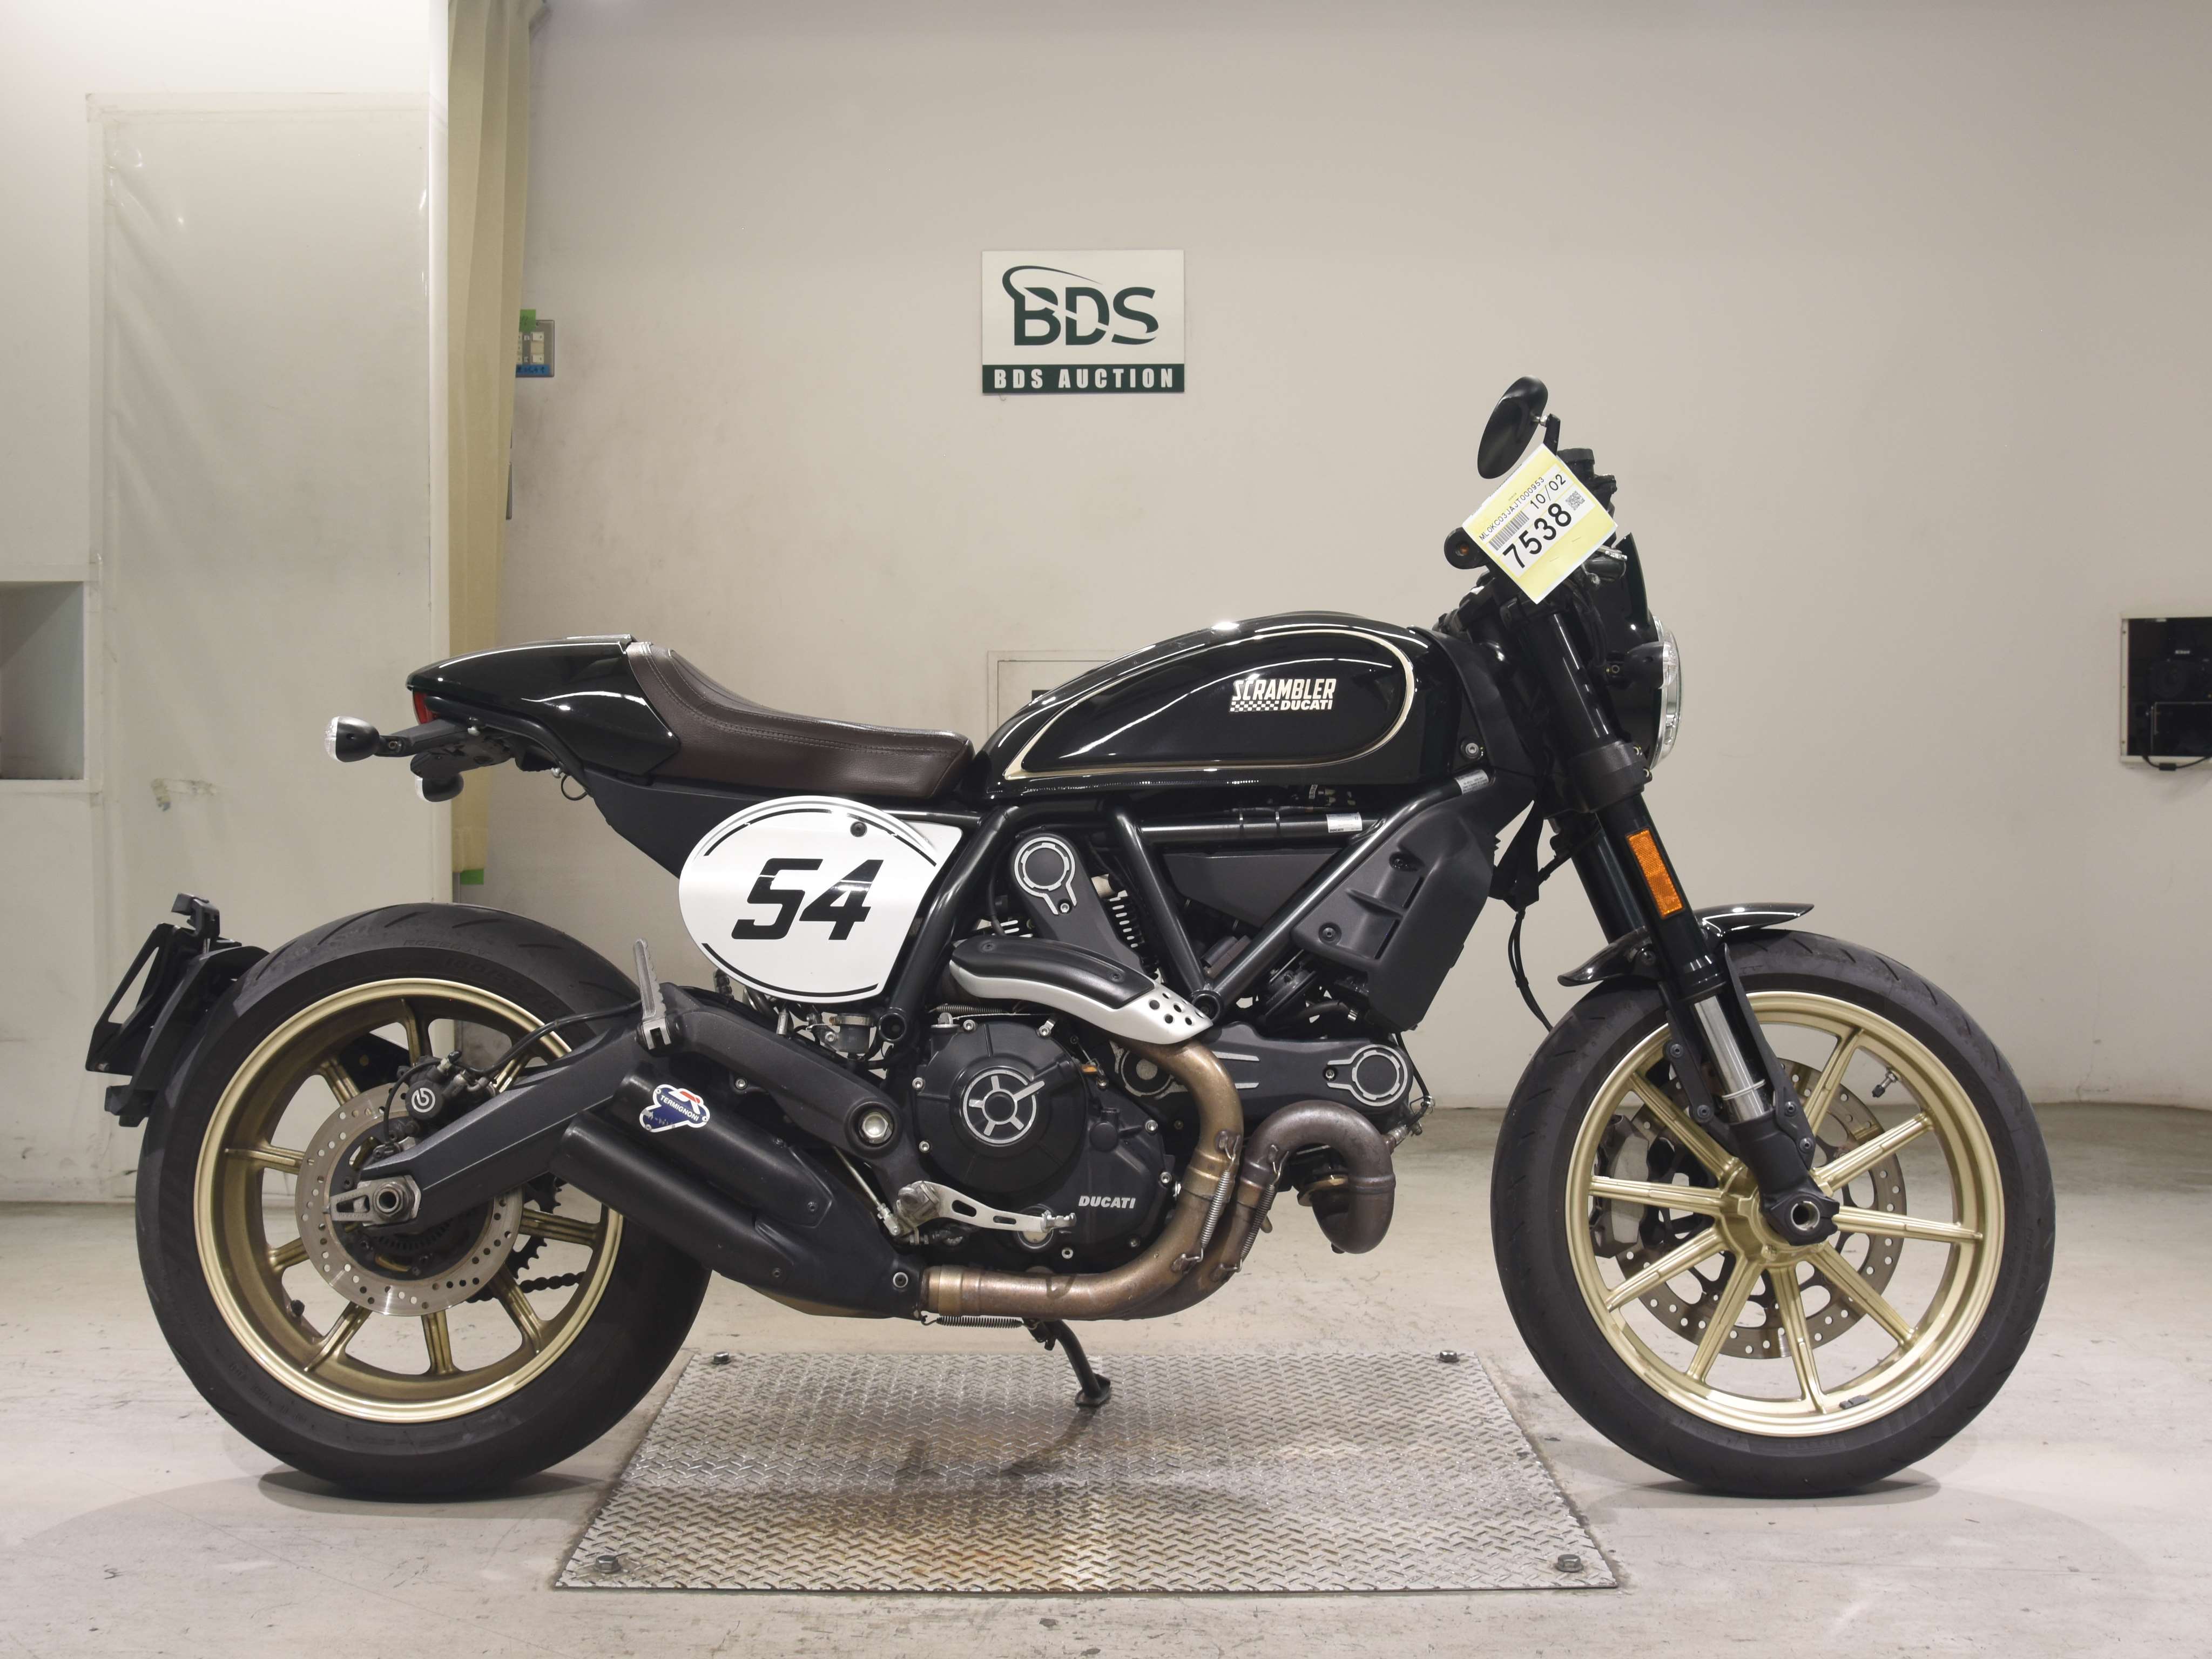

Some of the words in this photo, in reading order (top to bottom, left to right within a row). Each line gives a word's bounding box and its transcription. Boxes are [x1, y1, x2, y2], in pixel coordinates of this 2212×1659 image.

[1002, 266, 1159, 346] BDS
[994, 369, 1043, 389] BDS
[1058, 368, 1173, 388] AUCTION
[1530, 474, 1567, 510] 10/02
[1502, 503, 1572, 569] 7538
[1232, 678, 1337, 701] SCRAMBLER
[1280, 699, 1333, 711] DUCATI
[731, 858, 884, 940] 54
[660, 1094, 699, 1122] TERMIGNONI
[1078, 1195, 1136, 1209] DUCATI
